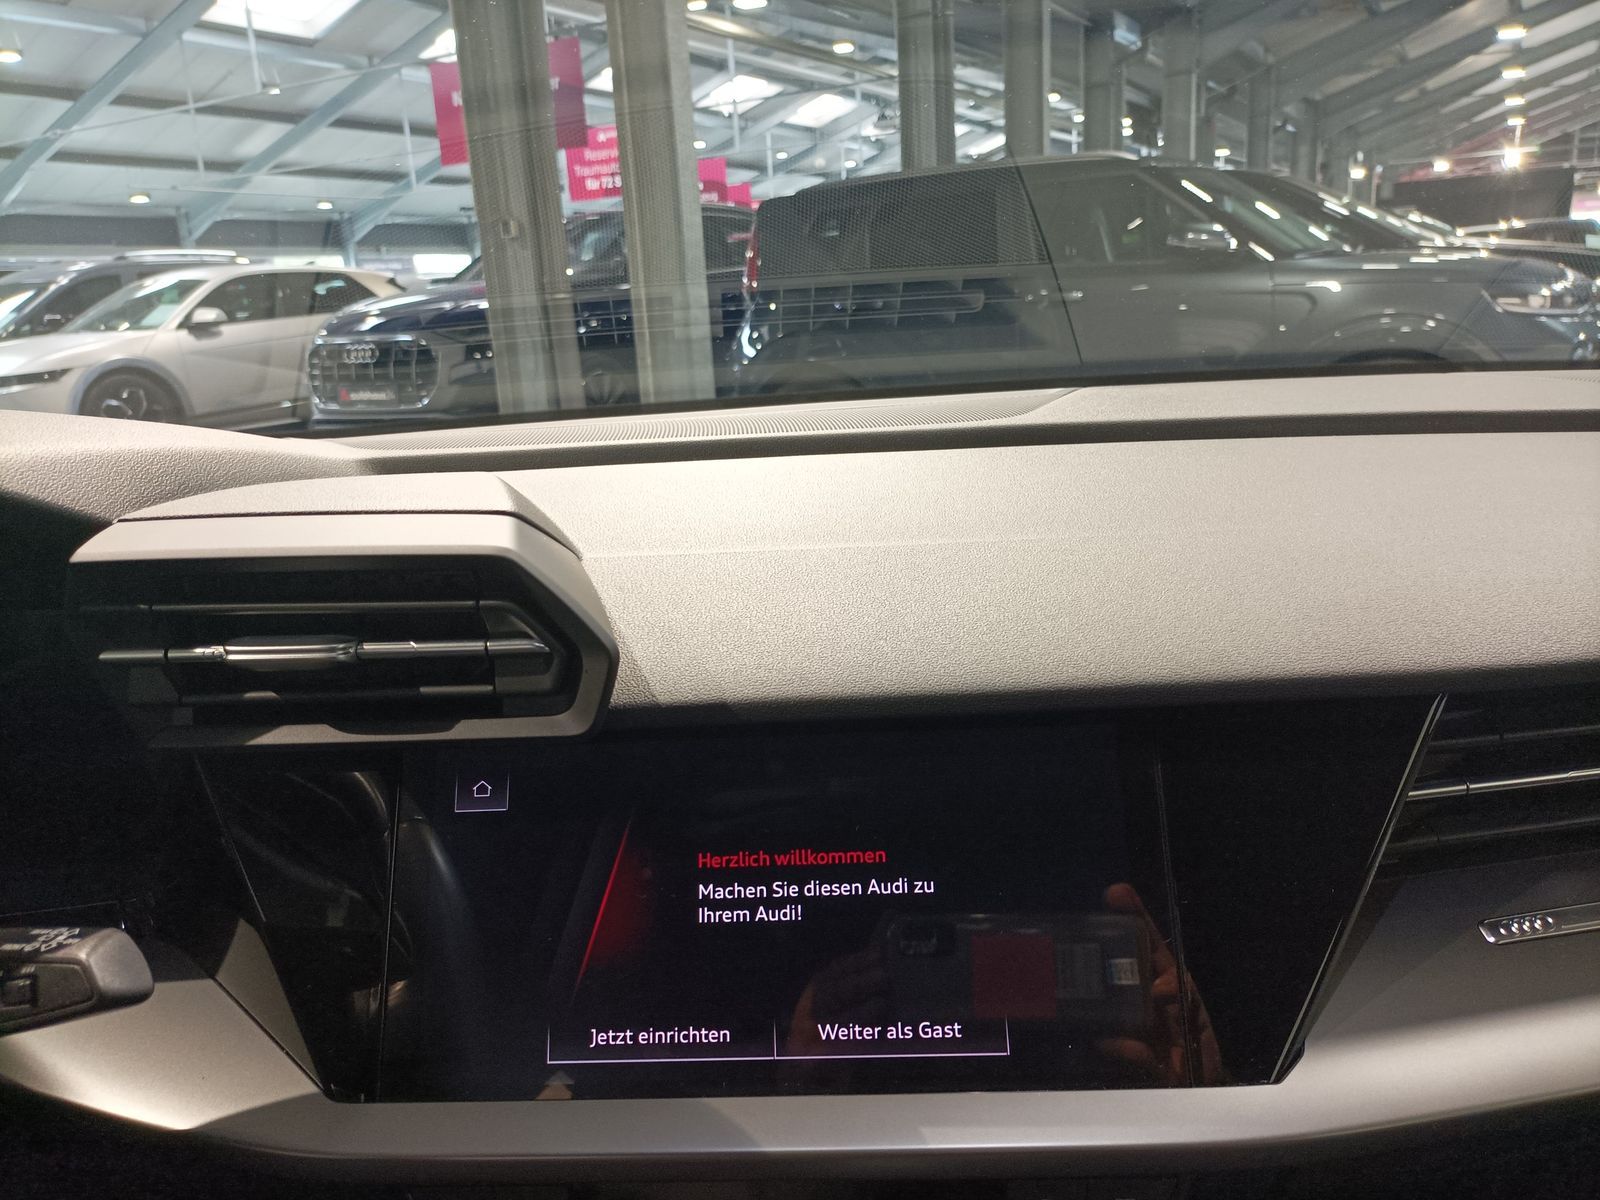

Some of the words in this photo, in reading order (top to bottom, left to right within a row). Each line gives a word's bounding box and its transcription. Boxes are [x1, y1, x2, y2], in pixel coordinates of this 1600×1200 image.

[601, 175, 614, 189] 72
[698, 850, 770, 868] Herzlich
[774, 849, 886, 866] willkommen
[698, 882, 767, 900] Machen
[772, 881, 799, 898] Sie
[803, 880, 862, 897] diesen
[868, 878, 908, 895] Audi
[914, 880, 935, 893] zu
[698, 907, 750, 923] Ihrem
[755, 905, 802, 922] Audi!
[589, 1028, 634, 1048] Jetzt
[638, 1026, 730, 1044] einrichten
[817, 1023, 882, 1041] Weiter
[887, 1022, 914, 1040] als
[918, 1021, 963, 1039] Gast
